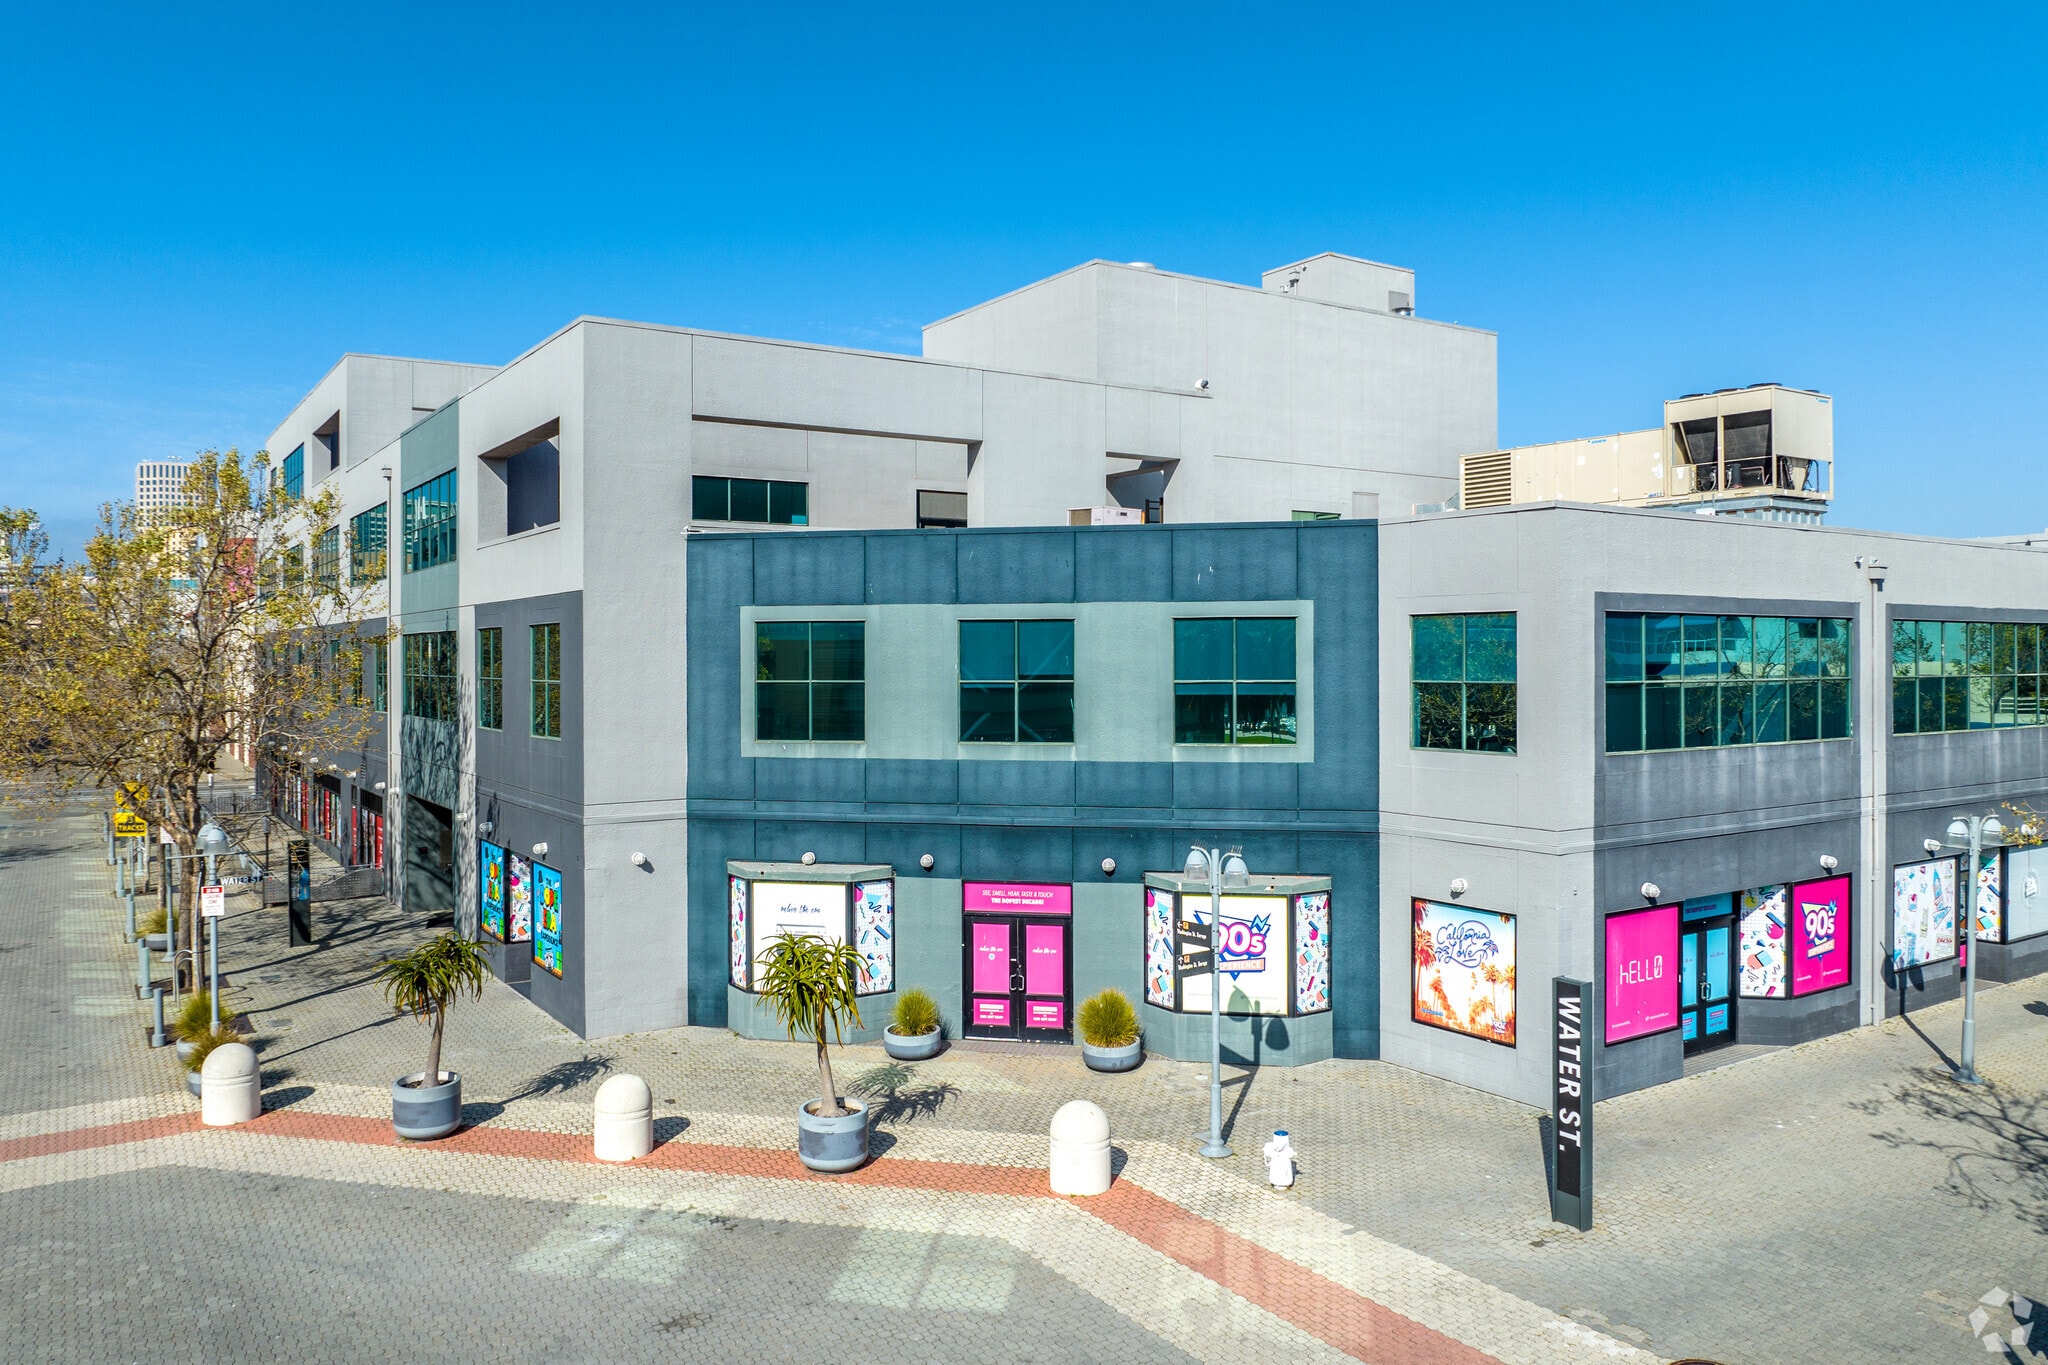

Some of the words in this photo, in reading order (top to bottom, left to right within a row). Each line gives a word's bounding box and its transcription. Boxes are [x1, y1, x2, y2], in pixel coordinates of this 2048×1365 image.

[118, 823, 145, 832] TRACKS
[220, 876, 249, 885] WATER
[1437, 920, 1491, 947] California
[1805, 909, 1835, 940] 90s
[1558, 997, 1581, 1099] WATER
[1559, 1108, 1581, 1152] ST.
